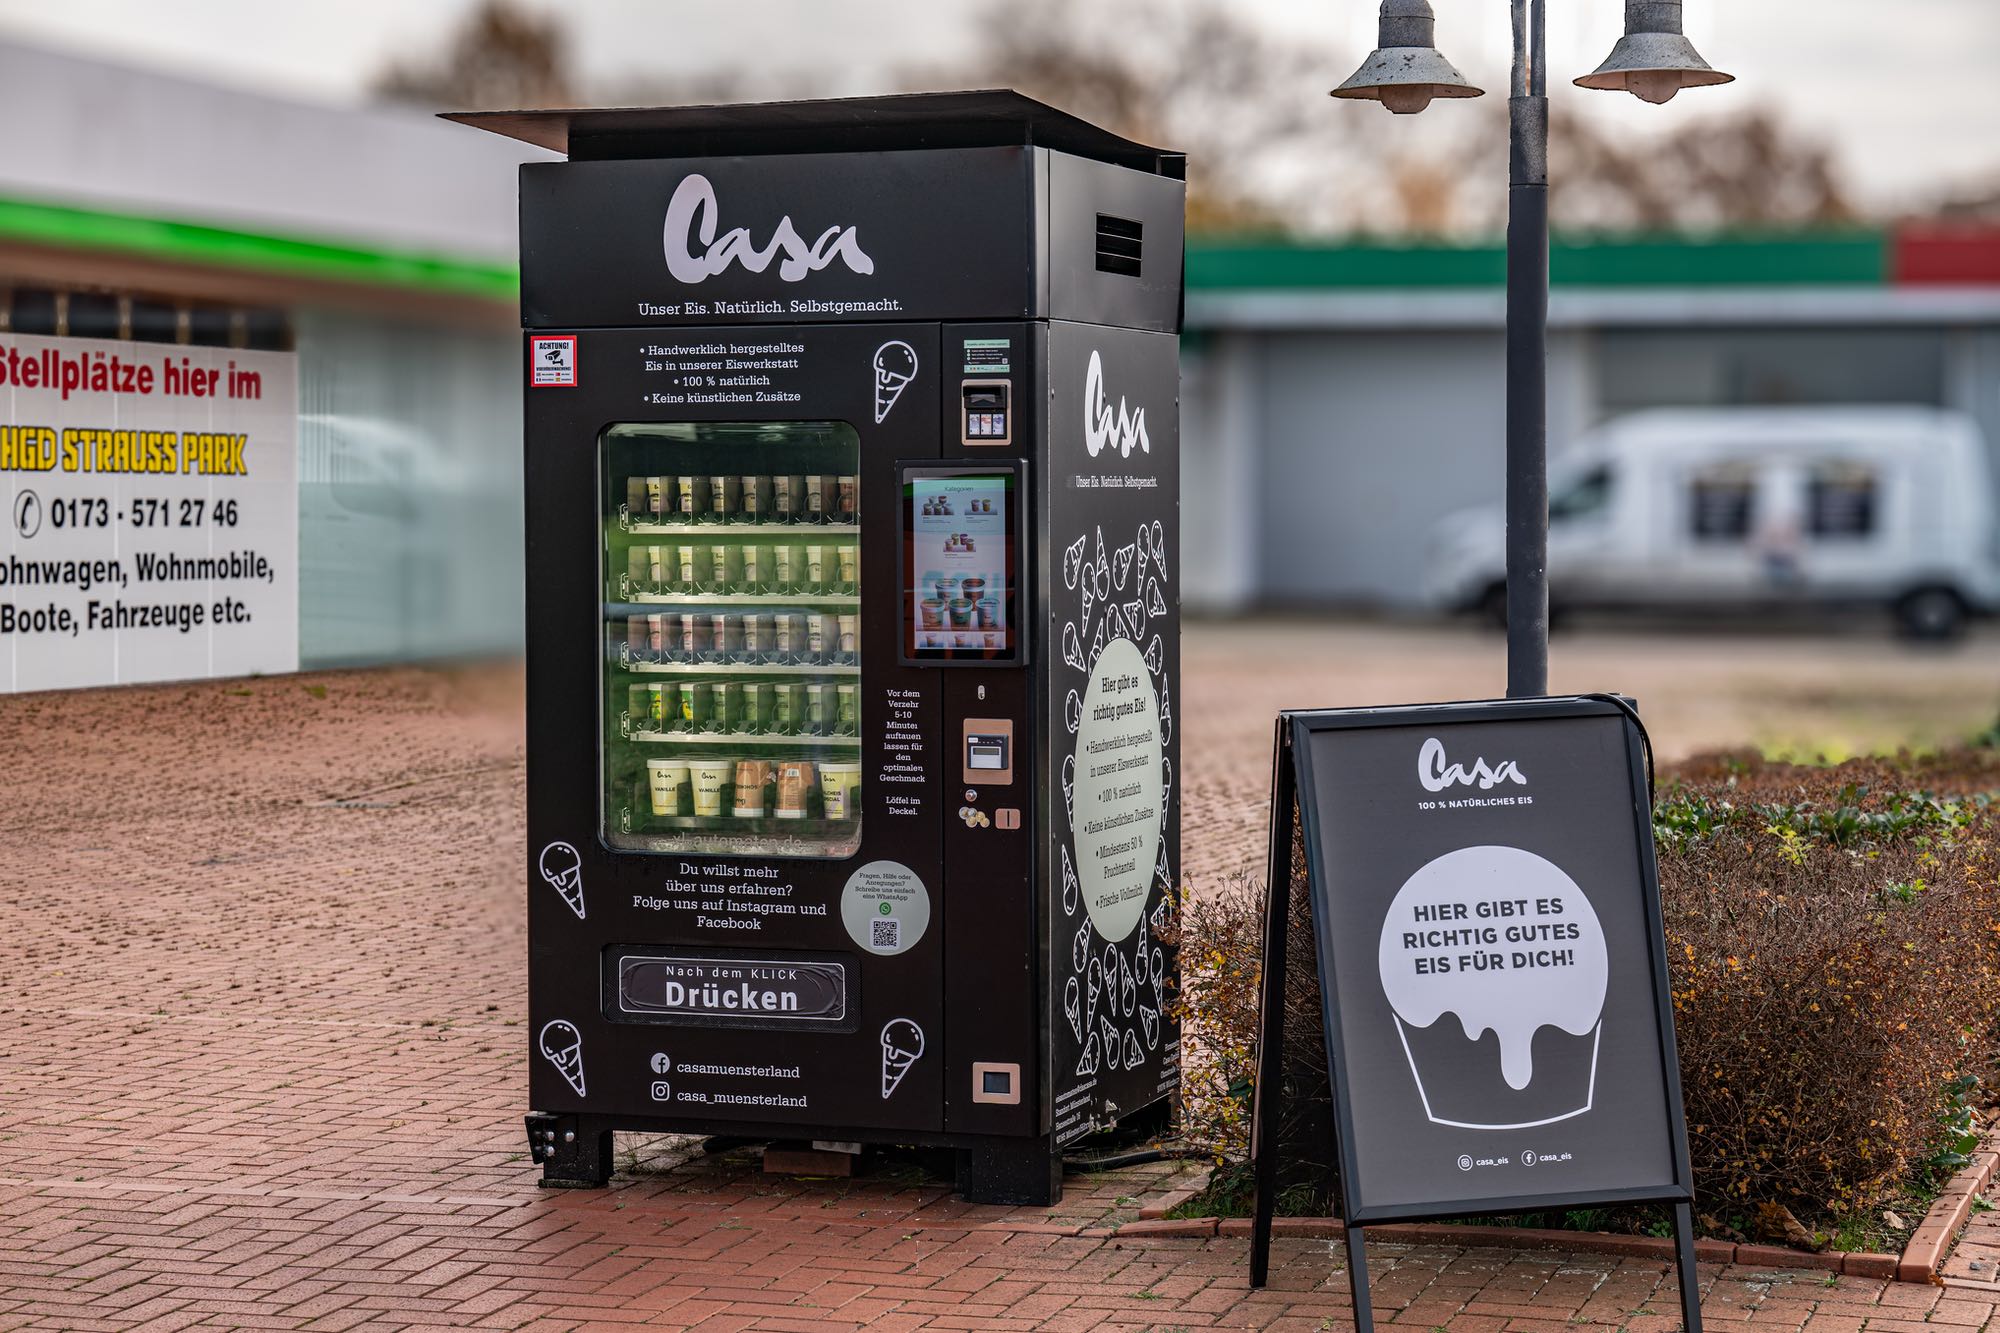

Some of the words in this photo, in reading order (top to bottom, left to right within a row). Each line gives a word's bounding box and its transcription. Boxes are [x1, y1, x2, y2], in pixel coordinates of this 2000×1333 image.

[663, 174, 874, 284] Casa
[638, 303, 680, 315] Unser
[684, 302, 710, 314] Eis.
[714, 300, 786, 314] Natürlich.
[790, 299, 903, 315] Selbstgemacht.
[539, 342, 569, 350] ACHTUNG!
[648, 344, 727, 356] Handwerklich
[730, 343, 804, 356] hergestelltes
[645, 360, 663, 372] Eis
[665, 361, 676, 371] in
[680, 361, 723, 370] unserer
[725, 358, 799, 370] Eiswerkstatt
[164, 357, 219, 398] hier
[228, 360, 261, 400] im
[682, 376, 702, 387] 100
[706, 376, 716, 386] %
[719, 376, 770, 386] natürlich
[652, 394, 684, 404] Keine
[686, 392, 753, 403] künstlichen
[756, 392, 801, 402] Zusätze
[1084, 350, 1150, 458] Casa
[62, 428, 178, 474] STRAUSS
[182, 432, 248, 476] PARK
[1076, 475, 1091, 488] Unser
[51, 499, 109, 528] 0173
[132, 499, 170, 528] 571
[180, 499, 205, 528] 27
[212, 498, 238, 528] 46
[136, 550, 275, 584] Wohnmobile,
[1, 603, 78, 638] Boote,
[88, 600, 204, 634] Fahrzeuge
[212, 597, 252, 624] etc.
[1102, 677, 1116, 693] Hier
[1117, 674, 1130, 694] gibt
[1131, 676, 1138, 688] es
[886, 690, 901, 698] Vor
[902, 690, 920, 698] dem
[888, 700, 919, 708] Verzehr
[1093, 702, 1116, 722] richtig
[1116, 702, 1134, 720] gutes
[1134, 697, 1146, 714] Eis!
[886, 732, 922, 740] auftauen
[910, 743, 923, 751] für
[1090, 736, 1126, 754] Handwerklich
[884, 764, 924, 773] optimalen
[1090, 765, 1096, 778] in
[1096, 763, 1116, 776] unserer
[1118, 755, 1149, 772] Eiswerkstatt
[1418, 737, 1527, 792] Casa
[880, 774, 926, 783] Geschmack
[886, 796, 909, 804] Löffel
[1102, 788, 1112, 802] 100
[1418, 802, 1436, 810] 100
[1438, 801, 1446, 809] %
[1448, 797, 1515, 808] NATÜRLICHES
[1518, 796, 1533, 805] EIS
[888, 808, 918, 816] Deckel.
[1088, 820, 1103, 834] Keine
[1104, 812, 1134, 830] künstlichen
[1100, 842, 1130, 859] Mindestens
[1130, 836, 1138, 850] 50
[680, 862, 698, 875] Du
[703, 864, 740, 876] willst
[744, 866, 779, 878] mehr
[859, 872, 882, 880] Fragen,
[665, 880, 696, 892] über
[700, 884, 725, 894] uns
[728, 882, 793, 896] erfahren?
[633, 896, 670, 910] Folge
[674, 900, 698, 910] uns
[702, 900, 724, 912] auf
[726, 900, 796, 916] Instagram
[800, 904, 827, 916] und
[876, 894, 908, 902] WhatsApp
[1100, 892, 1119, 908] Frische
[1414, 902, 1468, 922] HIER
[1476, 900, 1528, 918] GIBT
[1536, 898, 1564, 916] ES
[696, 916, 762, 930] Facebook
[1402, 927, 1498, 950] RICHTIG
[1504, 922, 1580, 943] GUTES
[1414, 956, 1451, 975] EIS
[1458, 950, 1505, 972] FÜR
[1512, 949, 1575, 969] DICH!
[666, 966, 703, 977] Nach
[712, 968, 742, 978] dem
[751, 968, 797, 980] KLICK
[666, 981, 798, 1011] Drücken
[676, 1063, 800, 1078] casamuensterland
[676, 1091, 808, 1107] casa_muensterland
[1476, 1156, 1509, 1166] casa_eis
[1540, 1152, 1572, 1162] casa_eis
